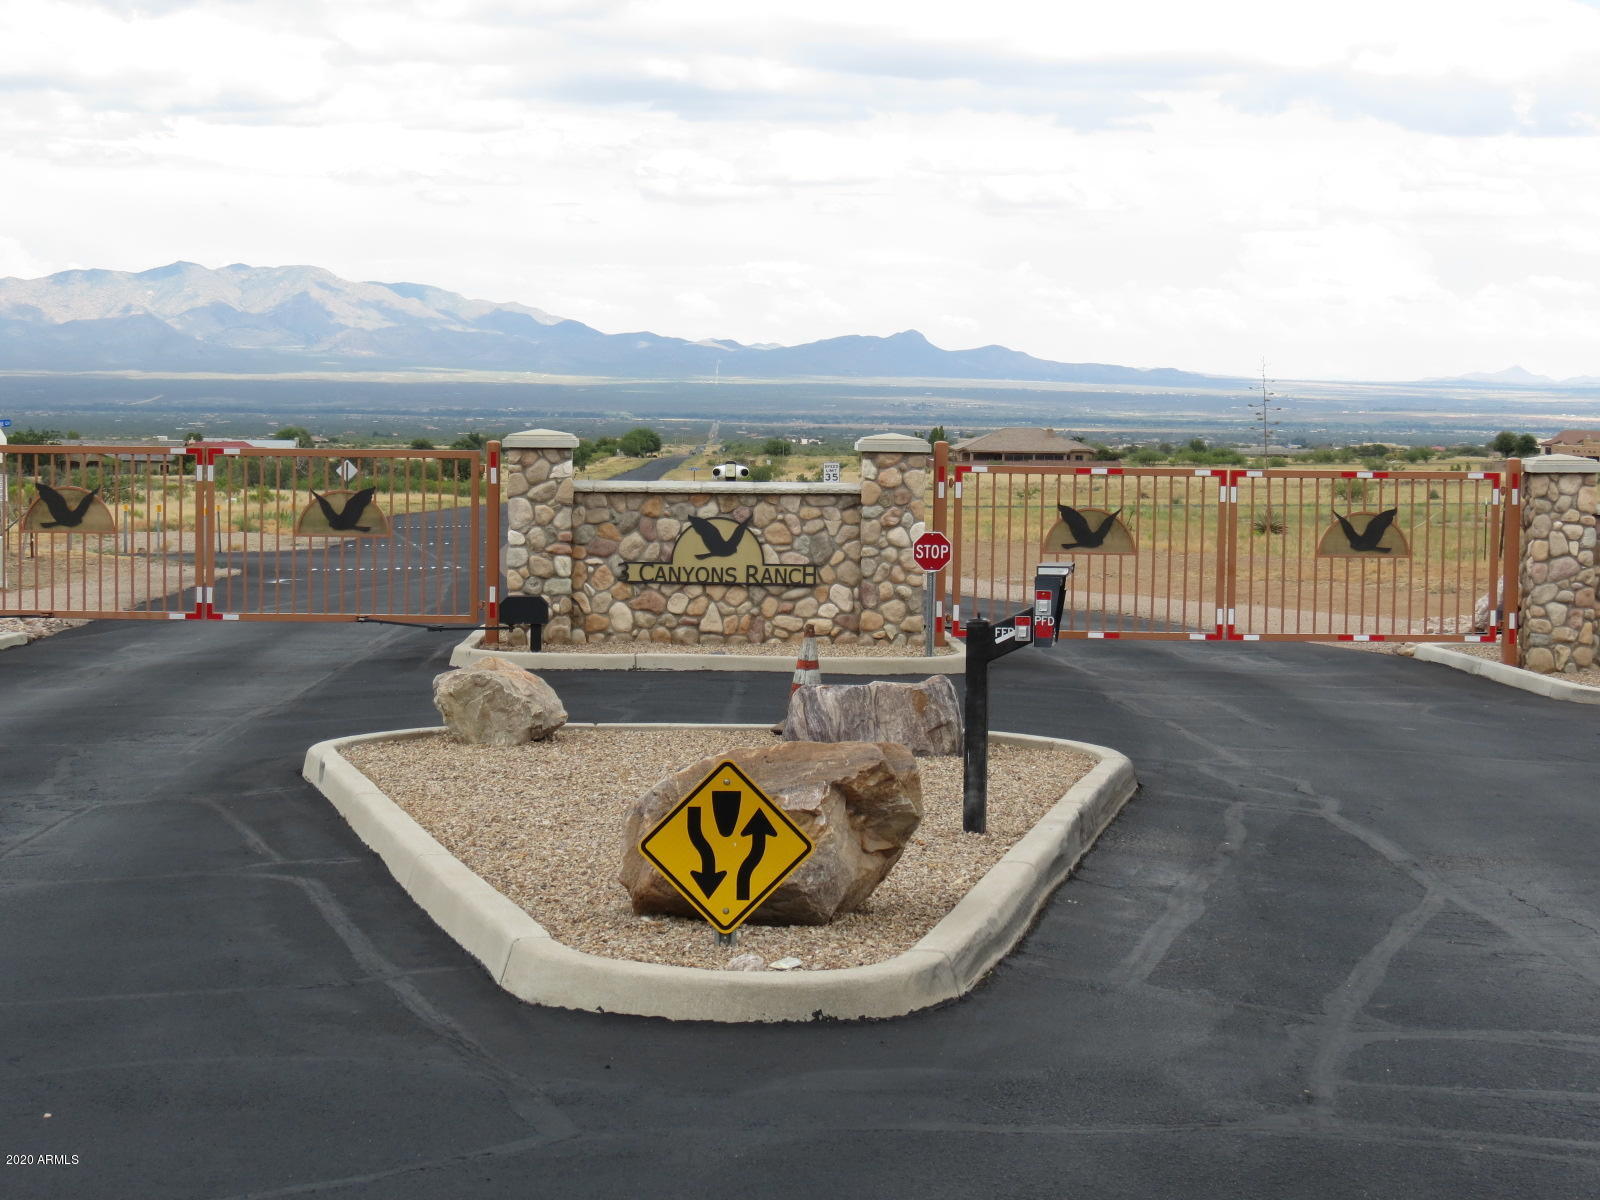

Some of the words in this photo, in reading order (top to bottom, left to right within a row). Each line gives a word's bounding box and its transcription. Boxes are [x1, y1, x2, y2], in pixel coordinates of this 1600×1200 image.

[825, 473, 838, 481] 35
[916, 544, 949, 559] STOP
[639, 563, 737, 584] CANYONS
[746, 564, 817, 585] RANCH
[1034, 615, 1055, 626] PFD
